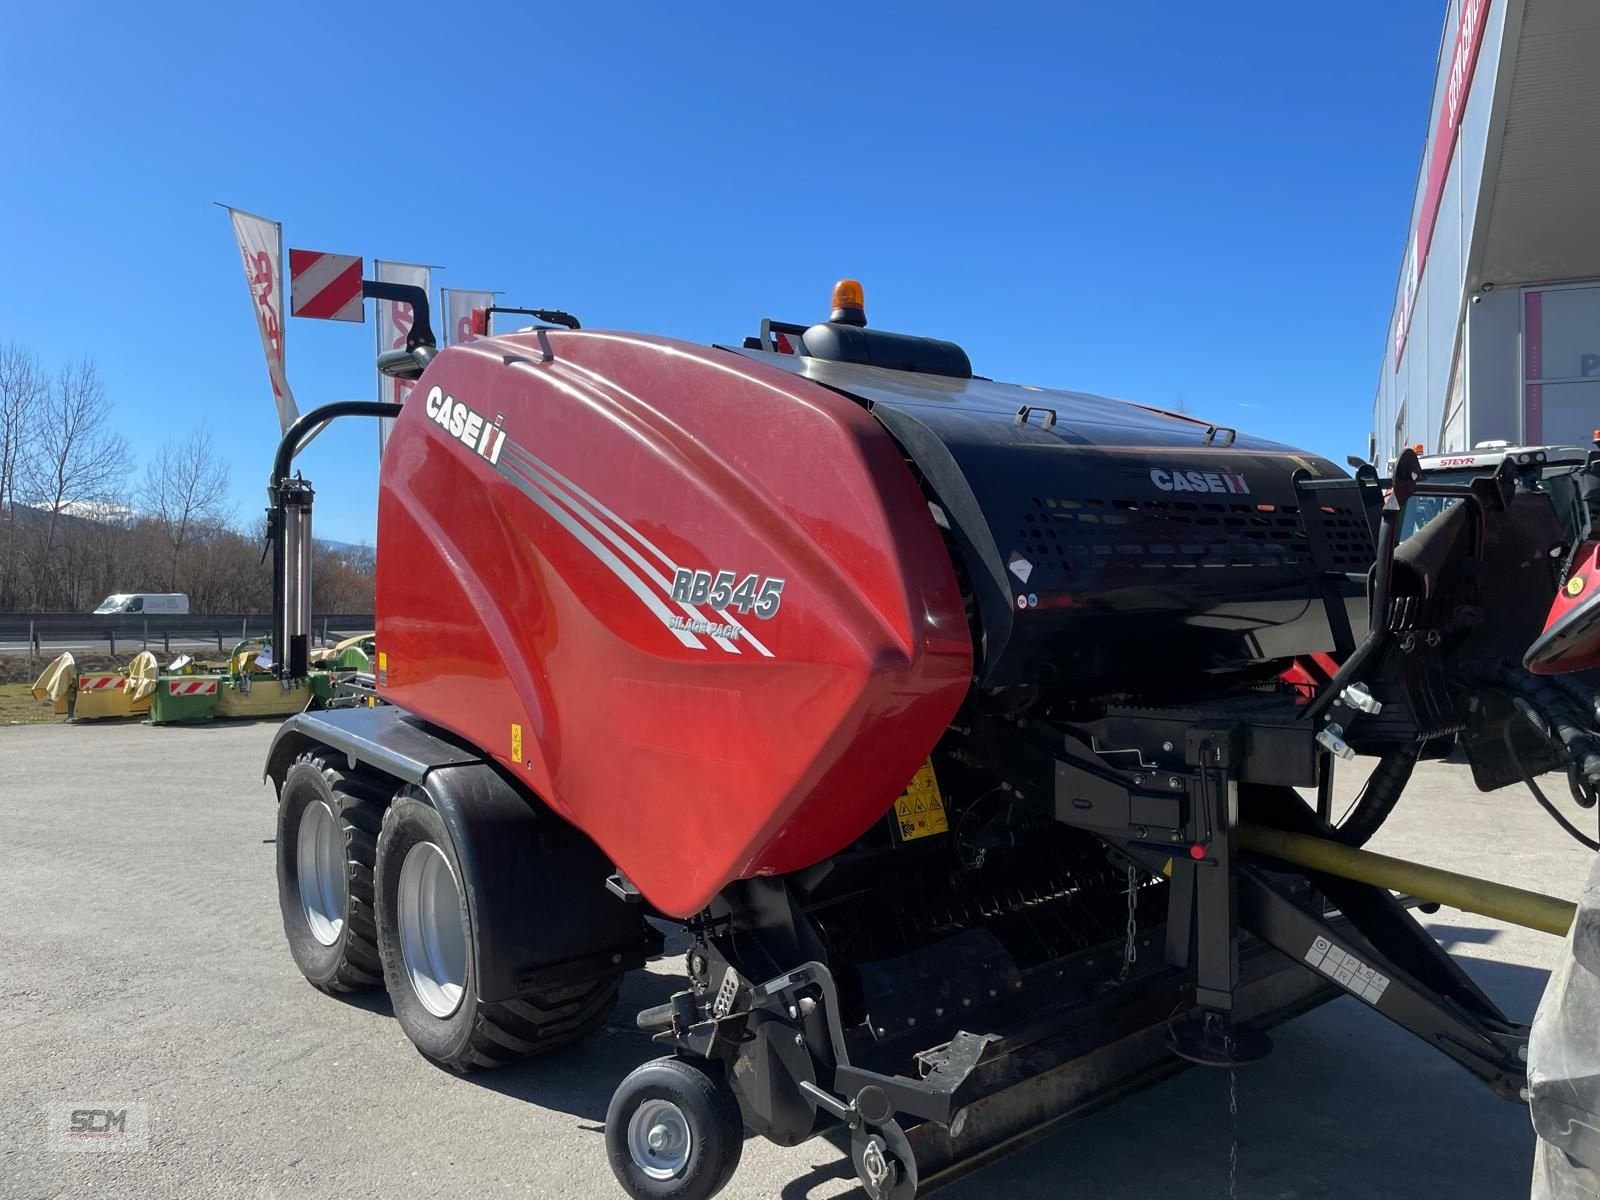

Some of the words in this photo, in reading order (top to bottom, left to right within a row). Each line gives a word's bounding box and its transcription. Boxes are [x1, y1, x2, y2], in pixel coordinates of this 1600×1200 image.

[426, 385, 484, 450] CASE
[1150, 469, 1227, 493] CASE
[1440, 457, 1476, 467] STEYR
[670, 567, 785, 620] RB545
